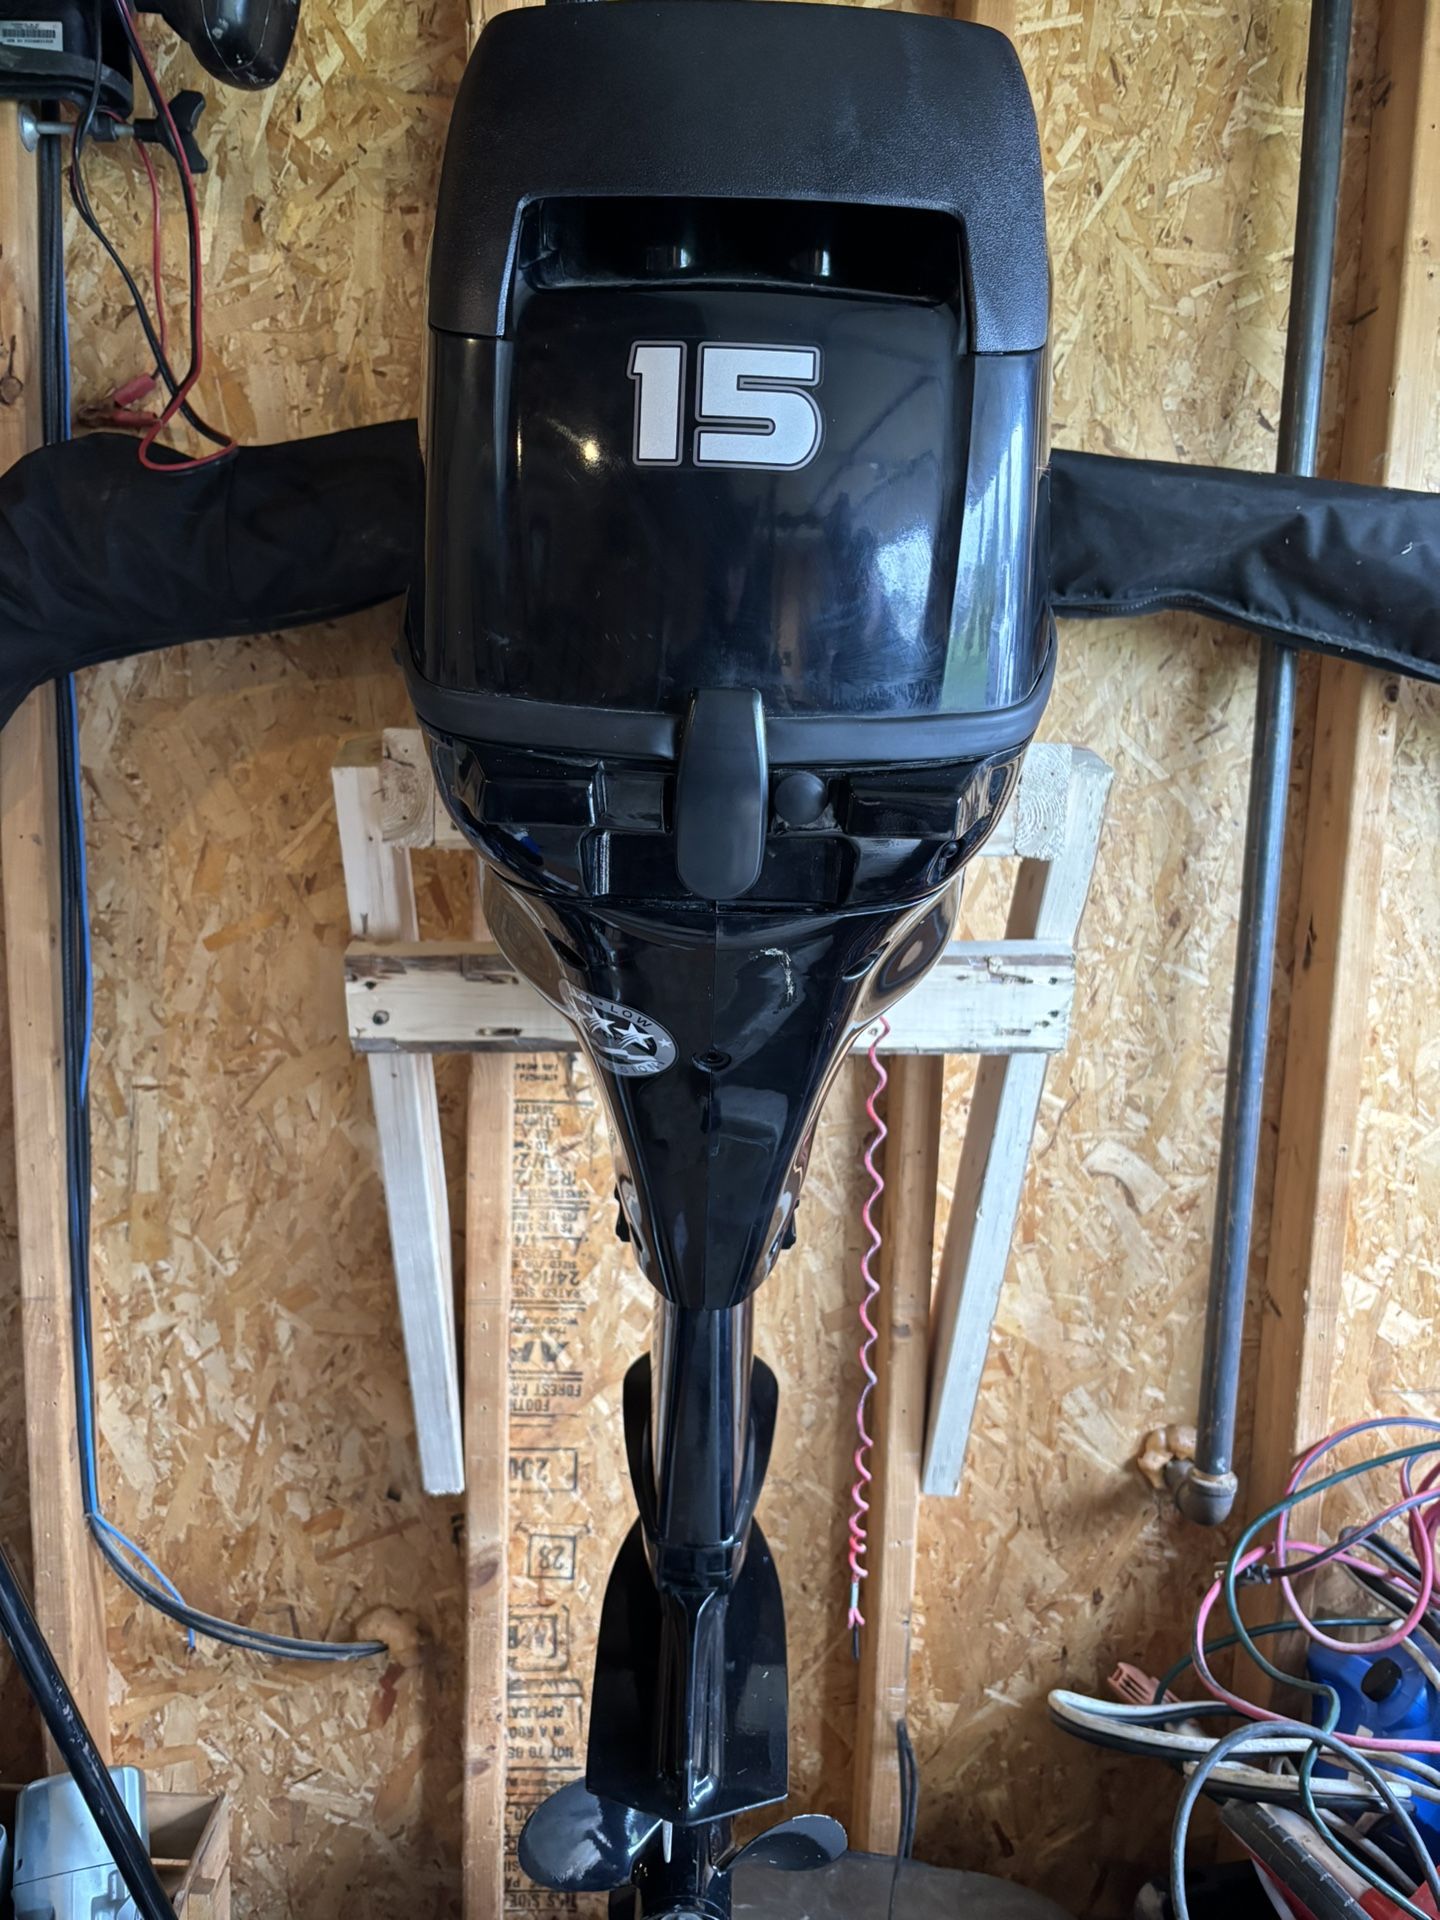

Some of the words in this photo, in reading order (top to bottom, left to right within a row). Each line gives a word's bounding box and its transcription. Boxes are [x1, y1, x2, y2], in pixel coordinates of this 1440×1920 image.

[627, 341, 822, 471] 15
[534, 1383, 581, 1397] FOREST
[538, 1546, 565, 1570] 28
[549, 1747, 574, 1759] NOT
